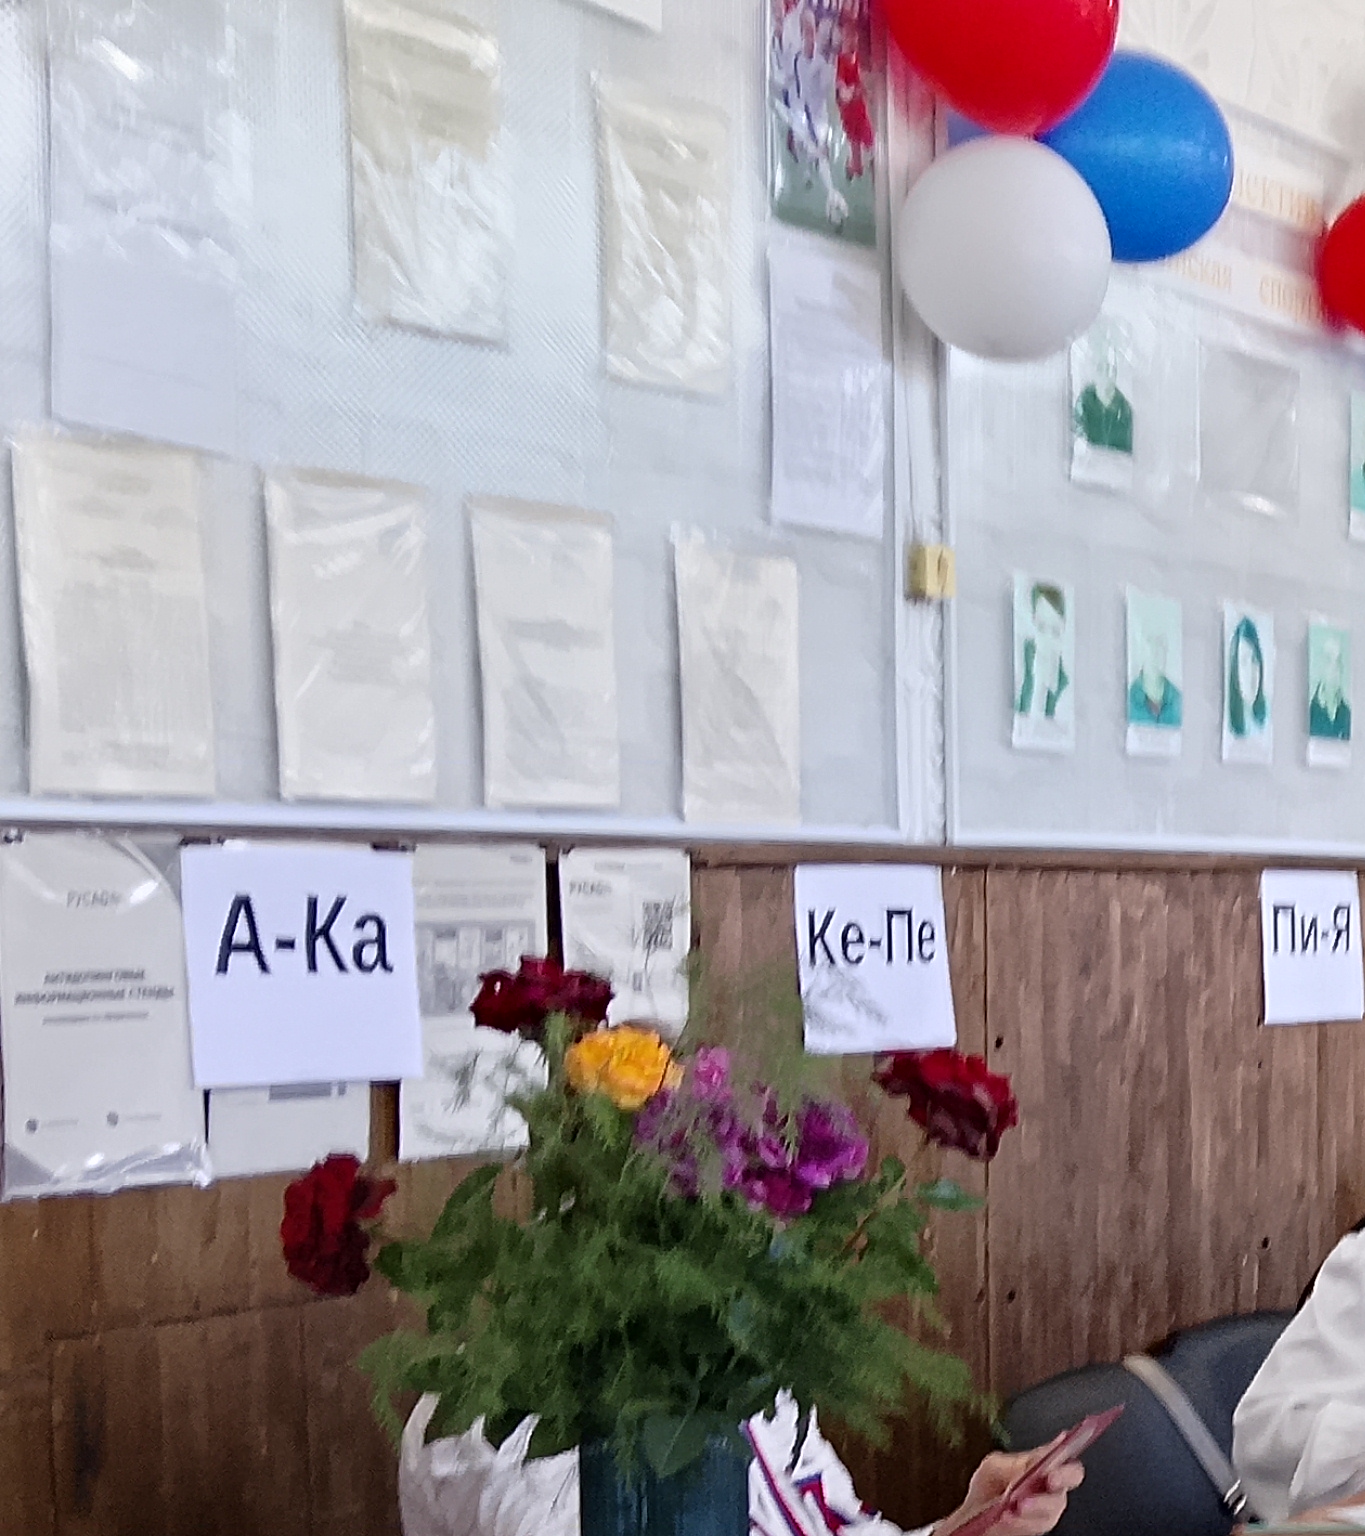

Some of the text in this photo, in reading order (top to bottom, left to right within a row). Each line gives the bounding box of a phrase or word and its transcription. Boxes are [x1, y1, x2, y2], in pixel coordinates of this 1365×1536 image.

[215, 893, 395, 974] А-Ка
[807, 906, 935, 967] Ке-Пе
[1272, 904, 1351, 953] Пи-Я
